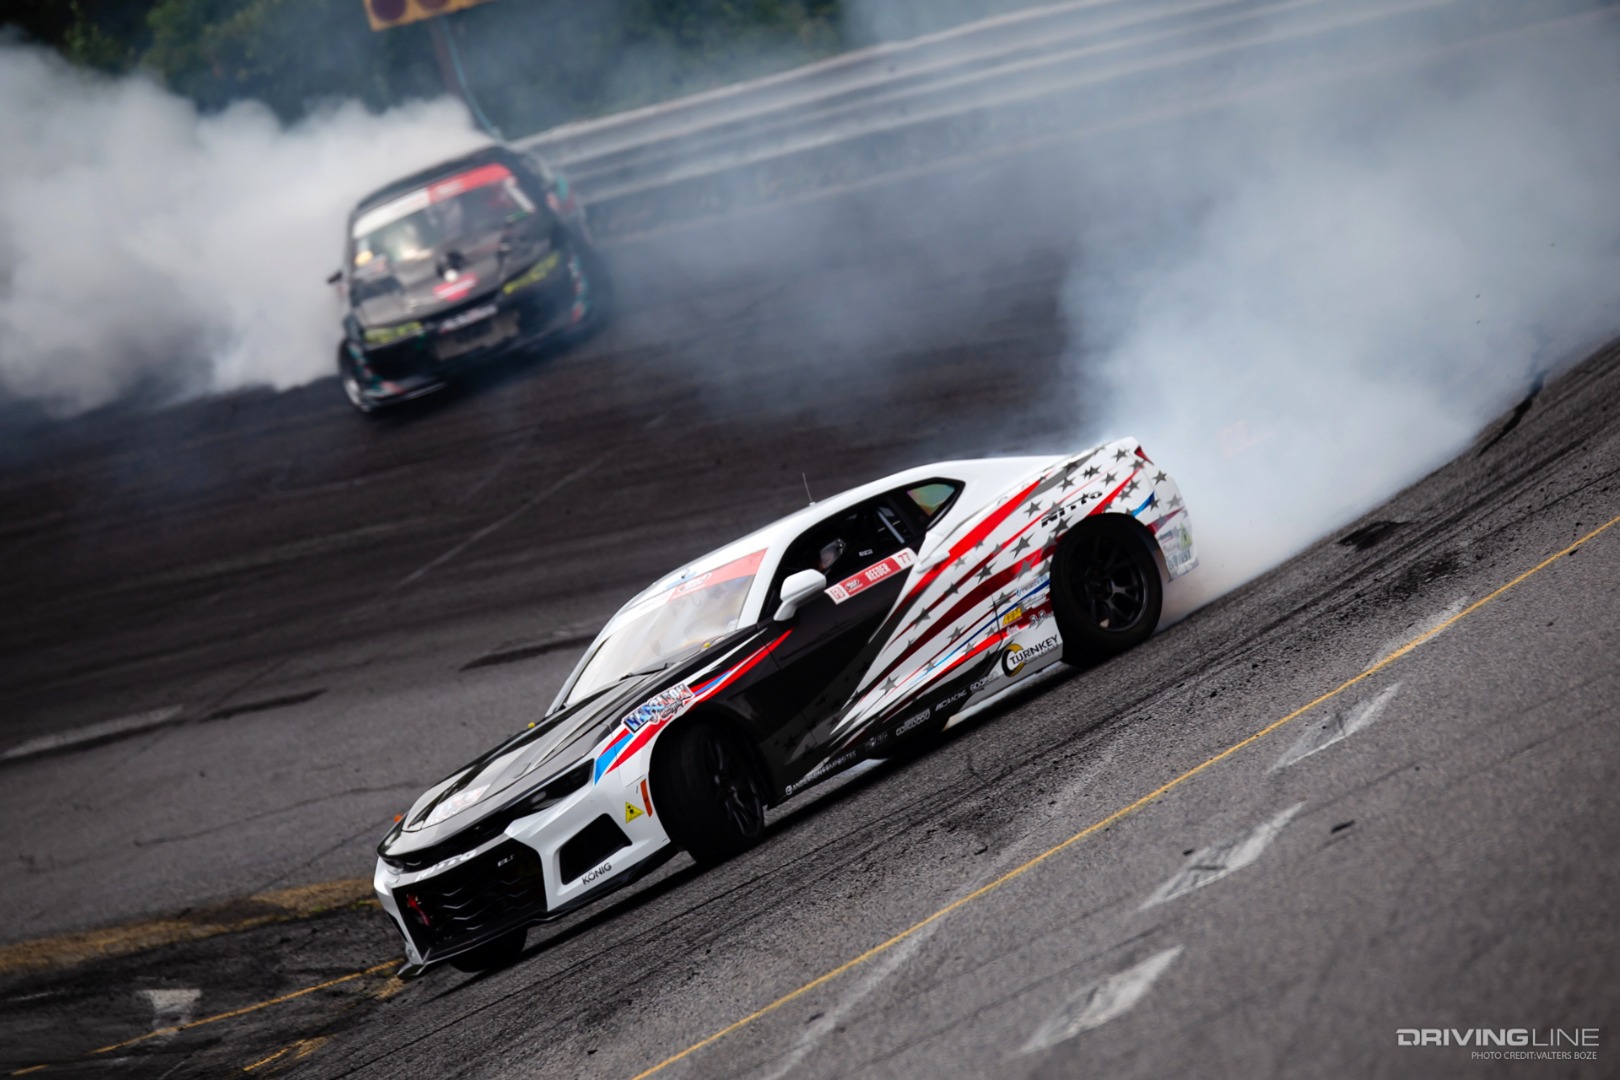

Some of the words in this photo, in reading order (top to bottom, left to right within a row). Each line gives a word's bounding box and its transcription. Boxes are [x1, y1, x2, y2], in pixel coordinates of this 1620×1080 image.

[1041, 491, 1103, 528] NITTO
[864, 562, 892, 582] REEDER
[897, 551, 911, 564] 77
[1009, 633, 1058, 665] TURNKEY
